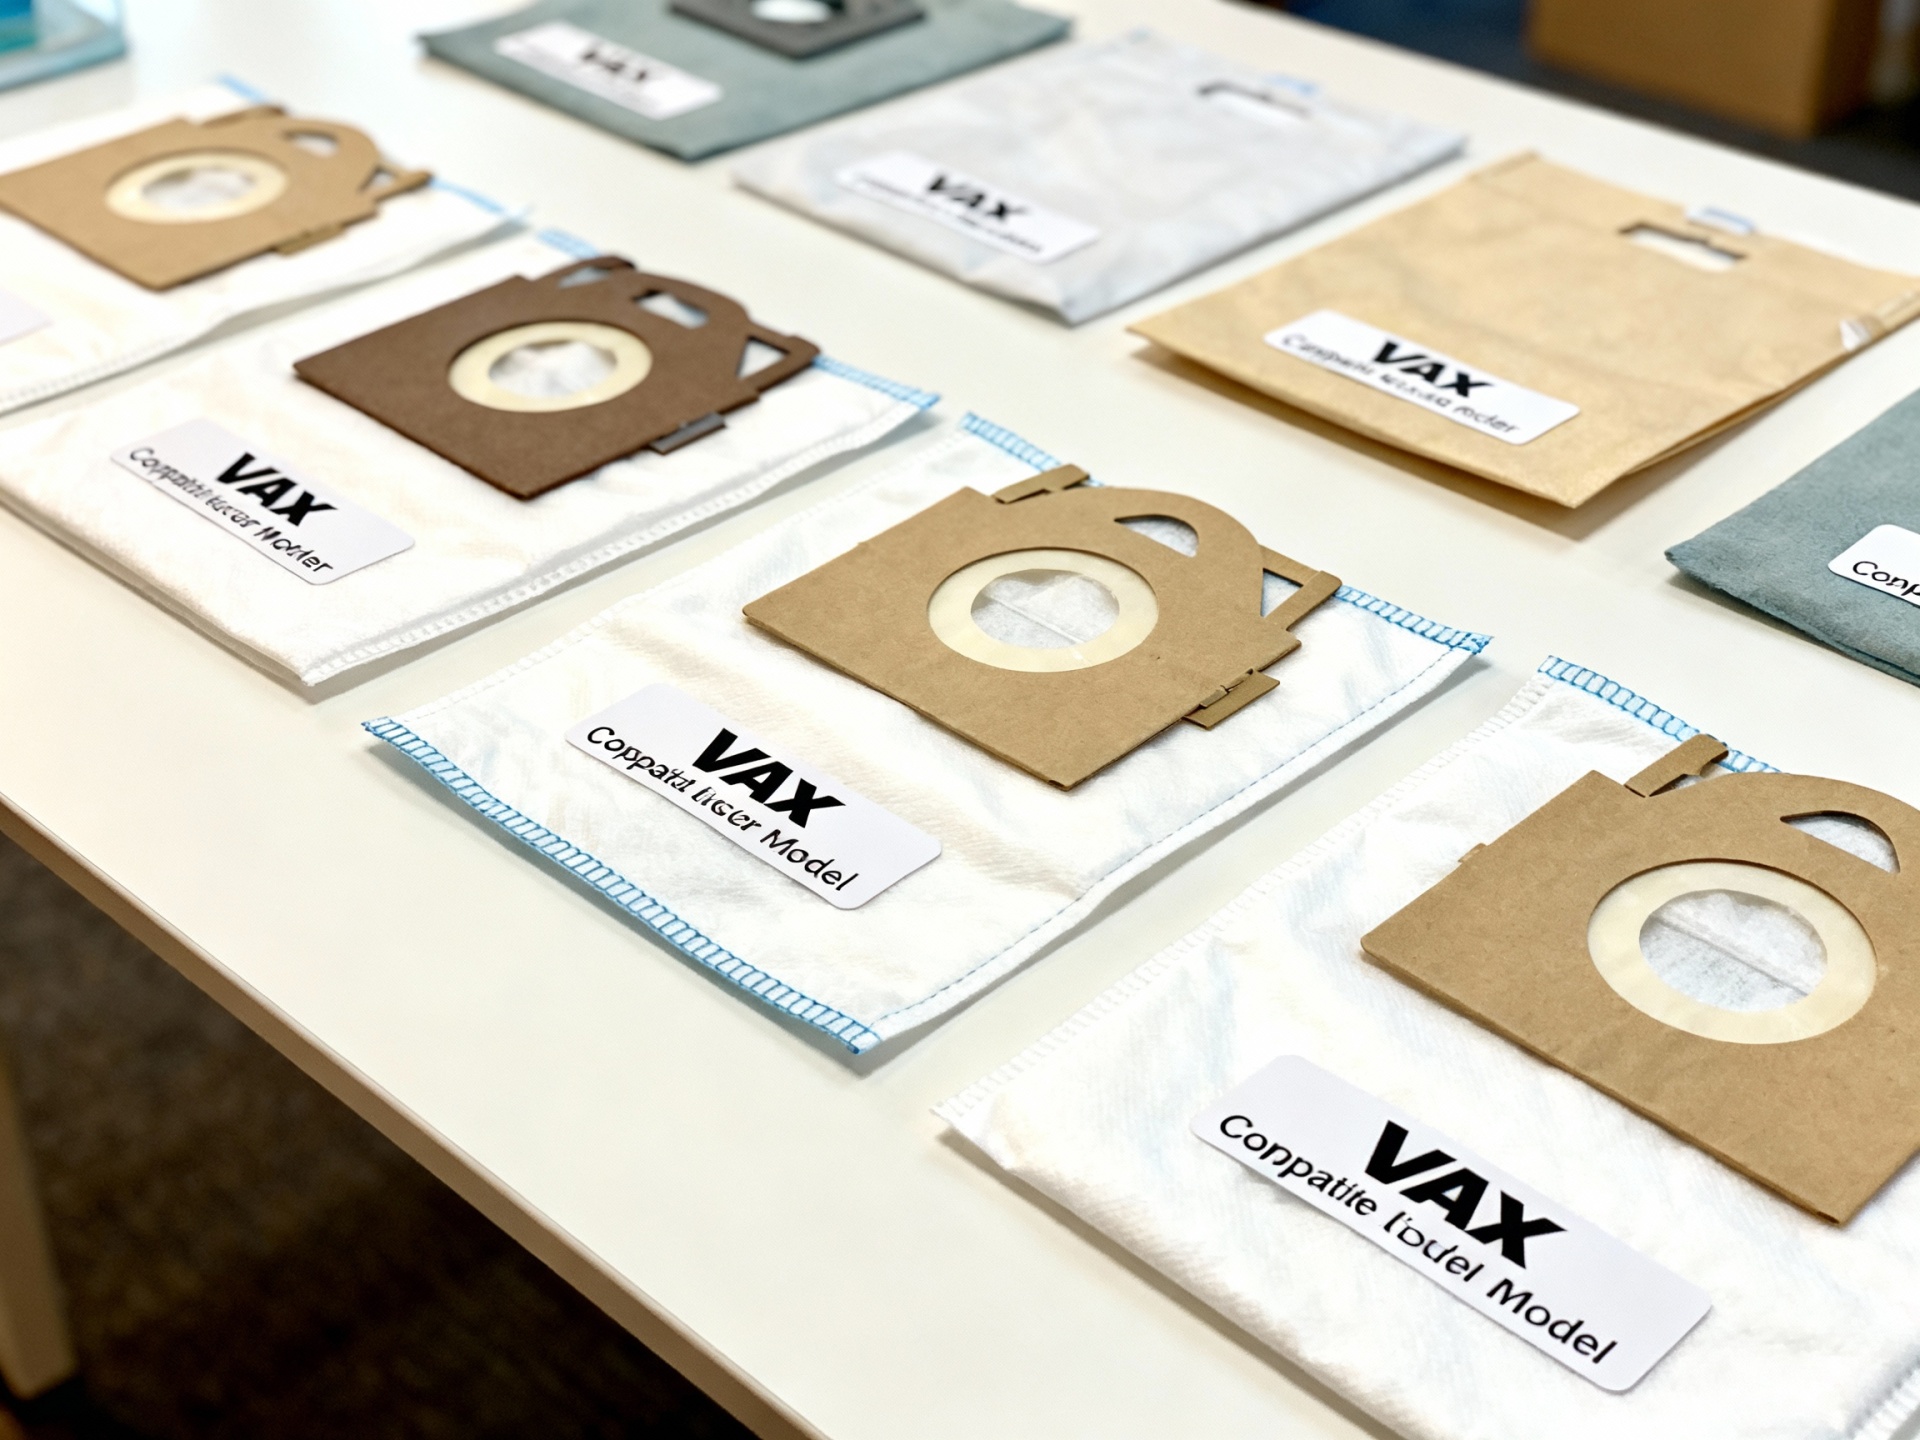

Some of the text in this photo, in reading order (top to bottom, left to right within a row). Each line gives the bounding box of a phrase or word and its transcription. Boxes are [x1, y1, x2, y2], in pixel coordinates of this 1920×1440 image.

[926, 169, 1028, 223] VAX
[1374, 341, 1494, 398] VAX
[216, 452, 337, 527] VAX
[692, 728, 846, 828] VAX
[760, 829, 859, 891] Model
[1364, 1120, 1567, 1269] VAX
[1487, 1278, 1618, 1364] Model
